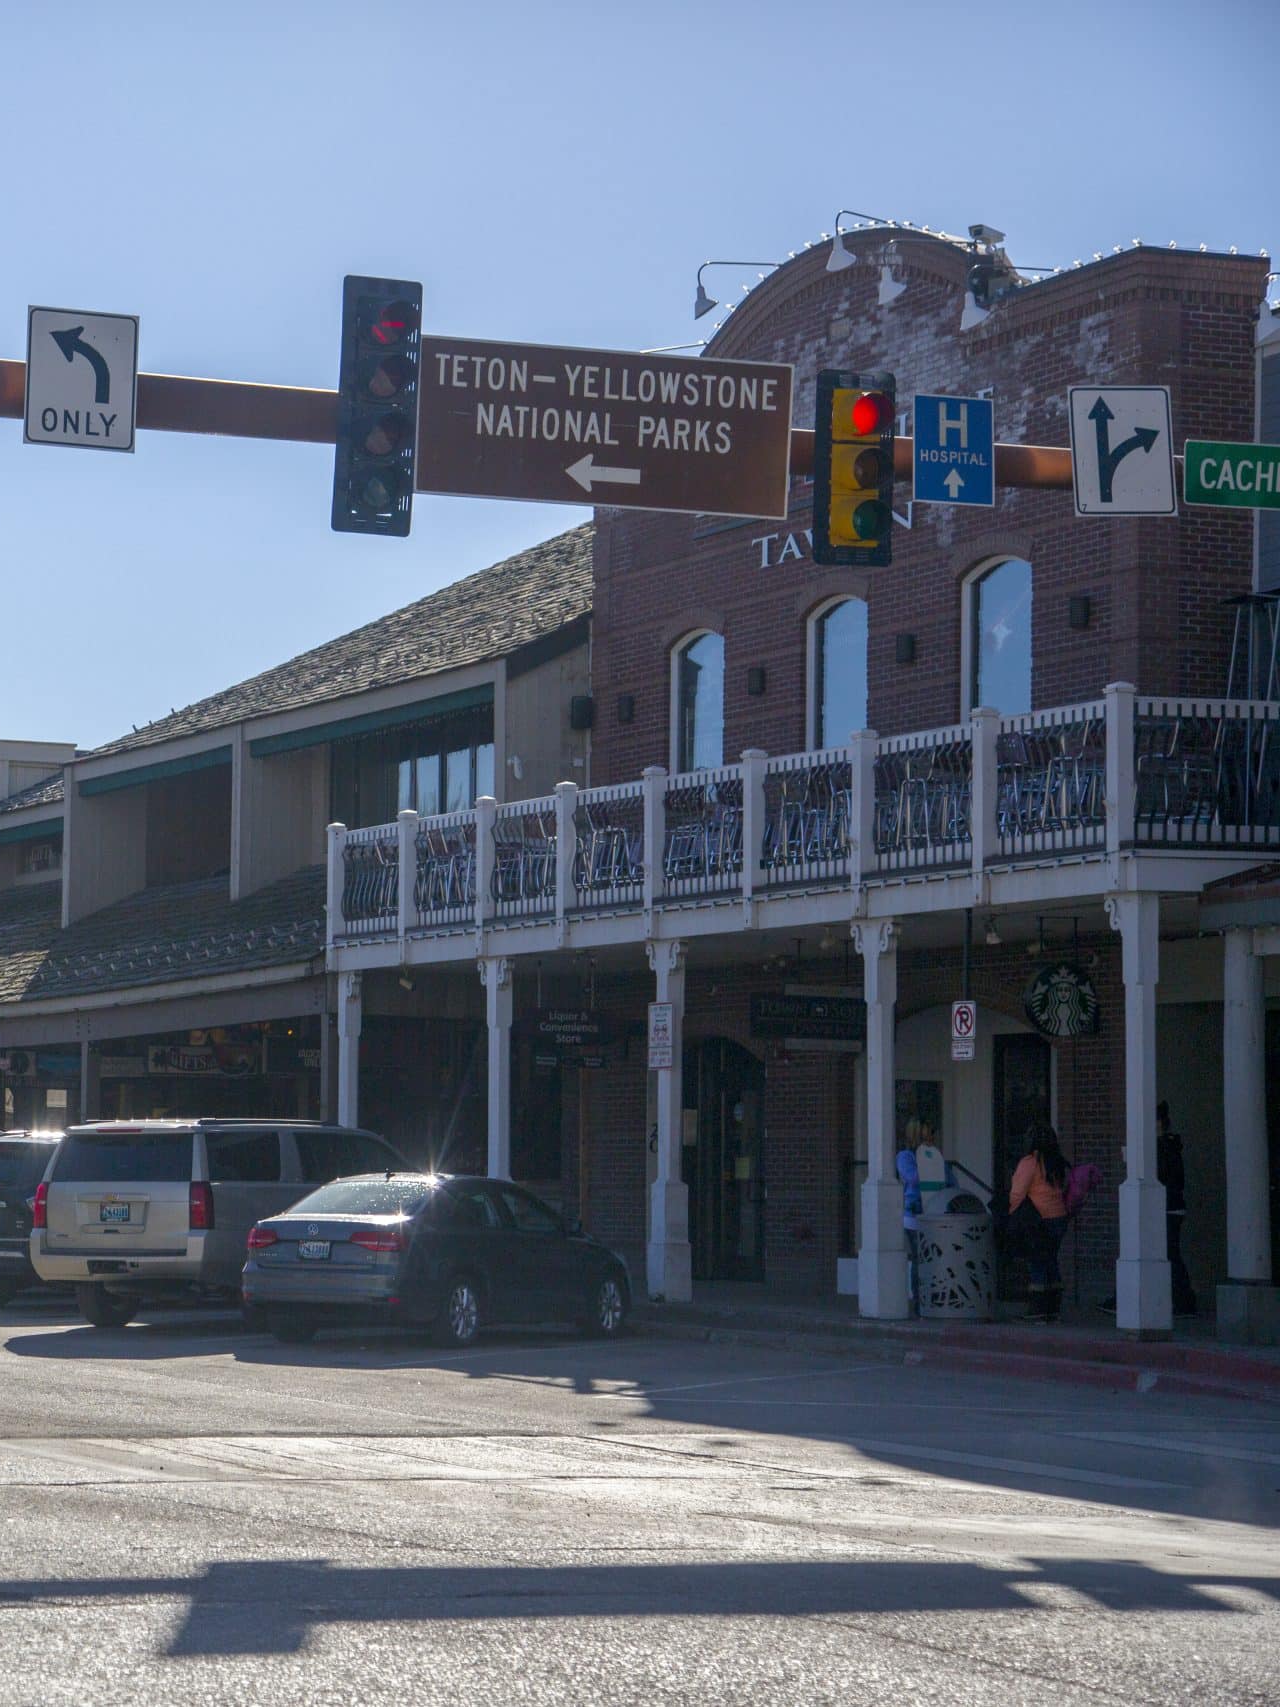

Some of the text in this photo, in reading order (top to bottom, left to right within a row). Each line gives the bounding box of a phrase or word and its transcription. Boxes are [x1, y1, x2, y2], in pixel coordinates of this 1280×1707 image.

[41, 408, 117, 437] ONLY
[476, 403, 732, 454] NATIONAL PARKS
[939, 401, 968, 448] H
[920, 448, 988, 466] HOSPITAL
[1200, 457, 1280, 493] CACH
[539, 1022, 599, 1032] Convenience
[548, 1010, 578, 1021] Liquor
[555, 1033, 582, 1043] Store
